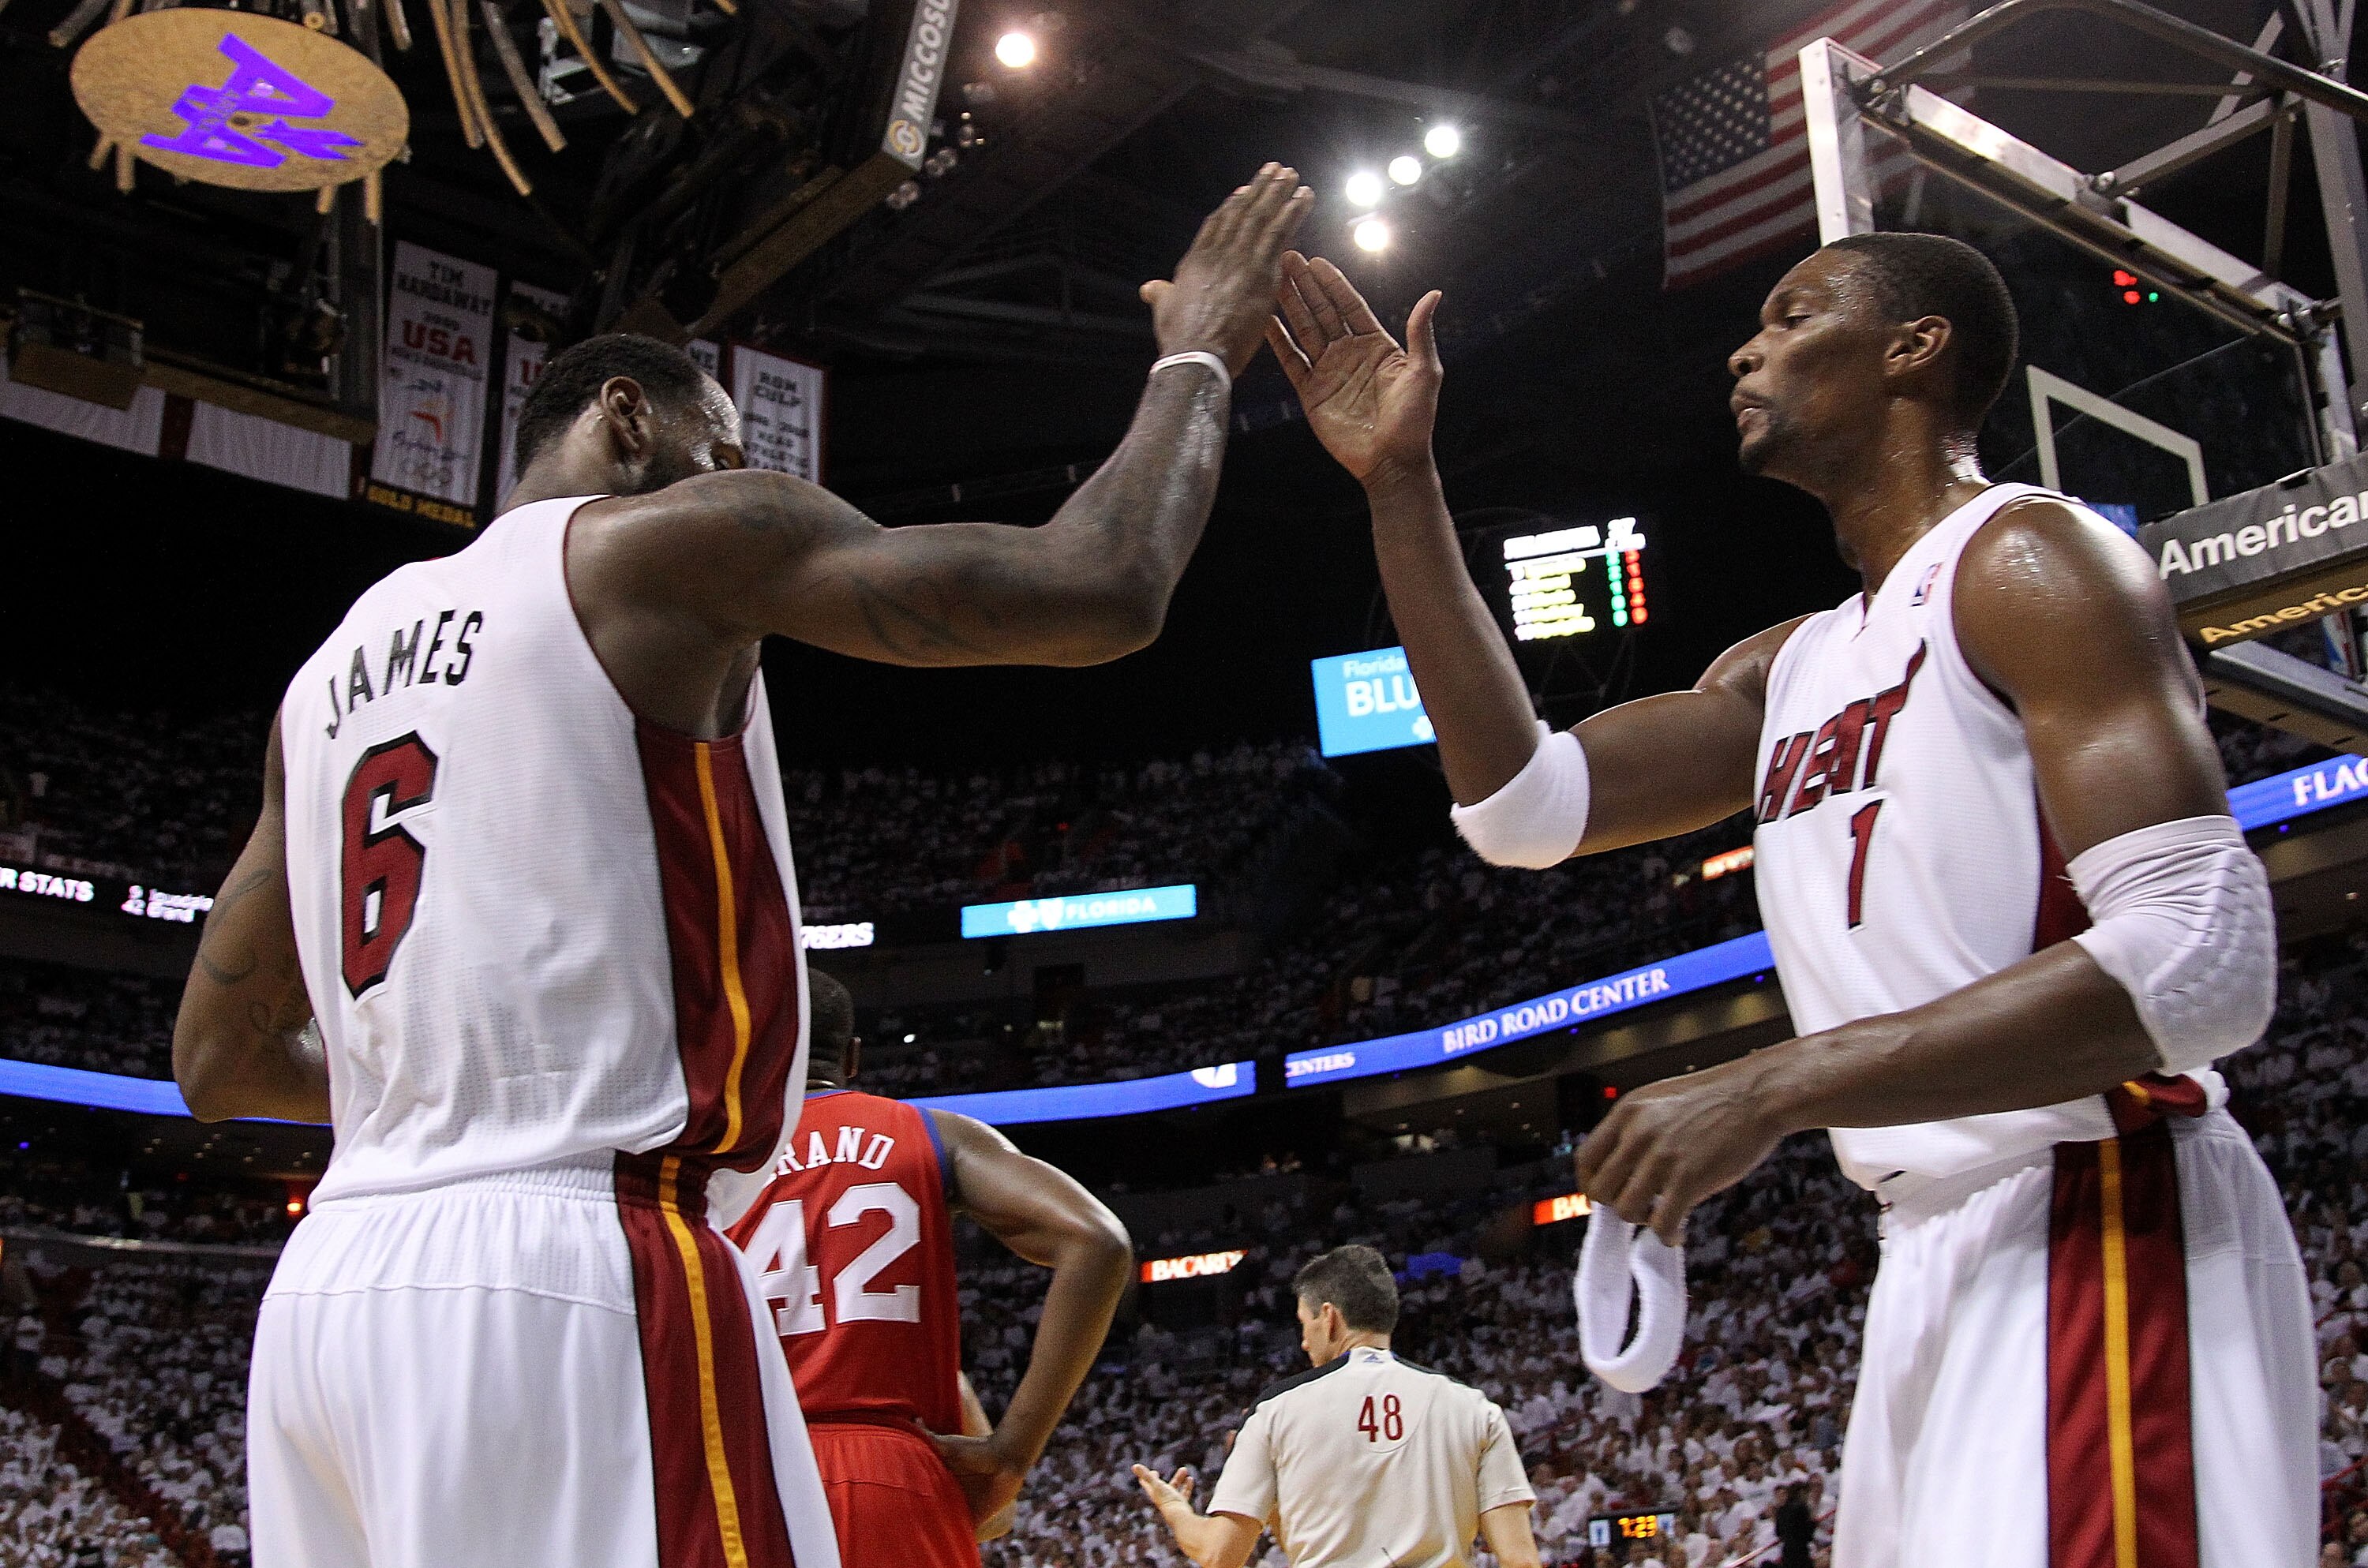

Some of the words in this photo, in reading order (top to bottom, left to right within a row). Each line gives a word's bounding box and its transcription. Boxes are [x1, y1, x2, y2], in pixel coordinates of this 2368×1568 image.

[403, 319, 476, 365] USA
[324, 608, 483, 740] JAMES
[1343, 654, 1407, 679] Florida
[1756, 637, 1928, 825] HEAT
[18, 870, 94, 902] STATS
[341, 729, 439, 1001] 6
[1847, 799, 1883, 930] 1
[1066, 896, 1157, 921] FLORIDA
[1442, 1019, 1499, 1054] BIRD
[1501, 997, 1569, 1037] ROAD
[1570, 967, 1671, 1016] CENTER
[762, 1125, 896, 1188] RAND
[743, 1182, 921, 1337] 42
[1357, 1393, 1403, 1443] 48
